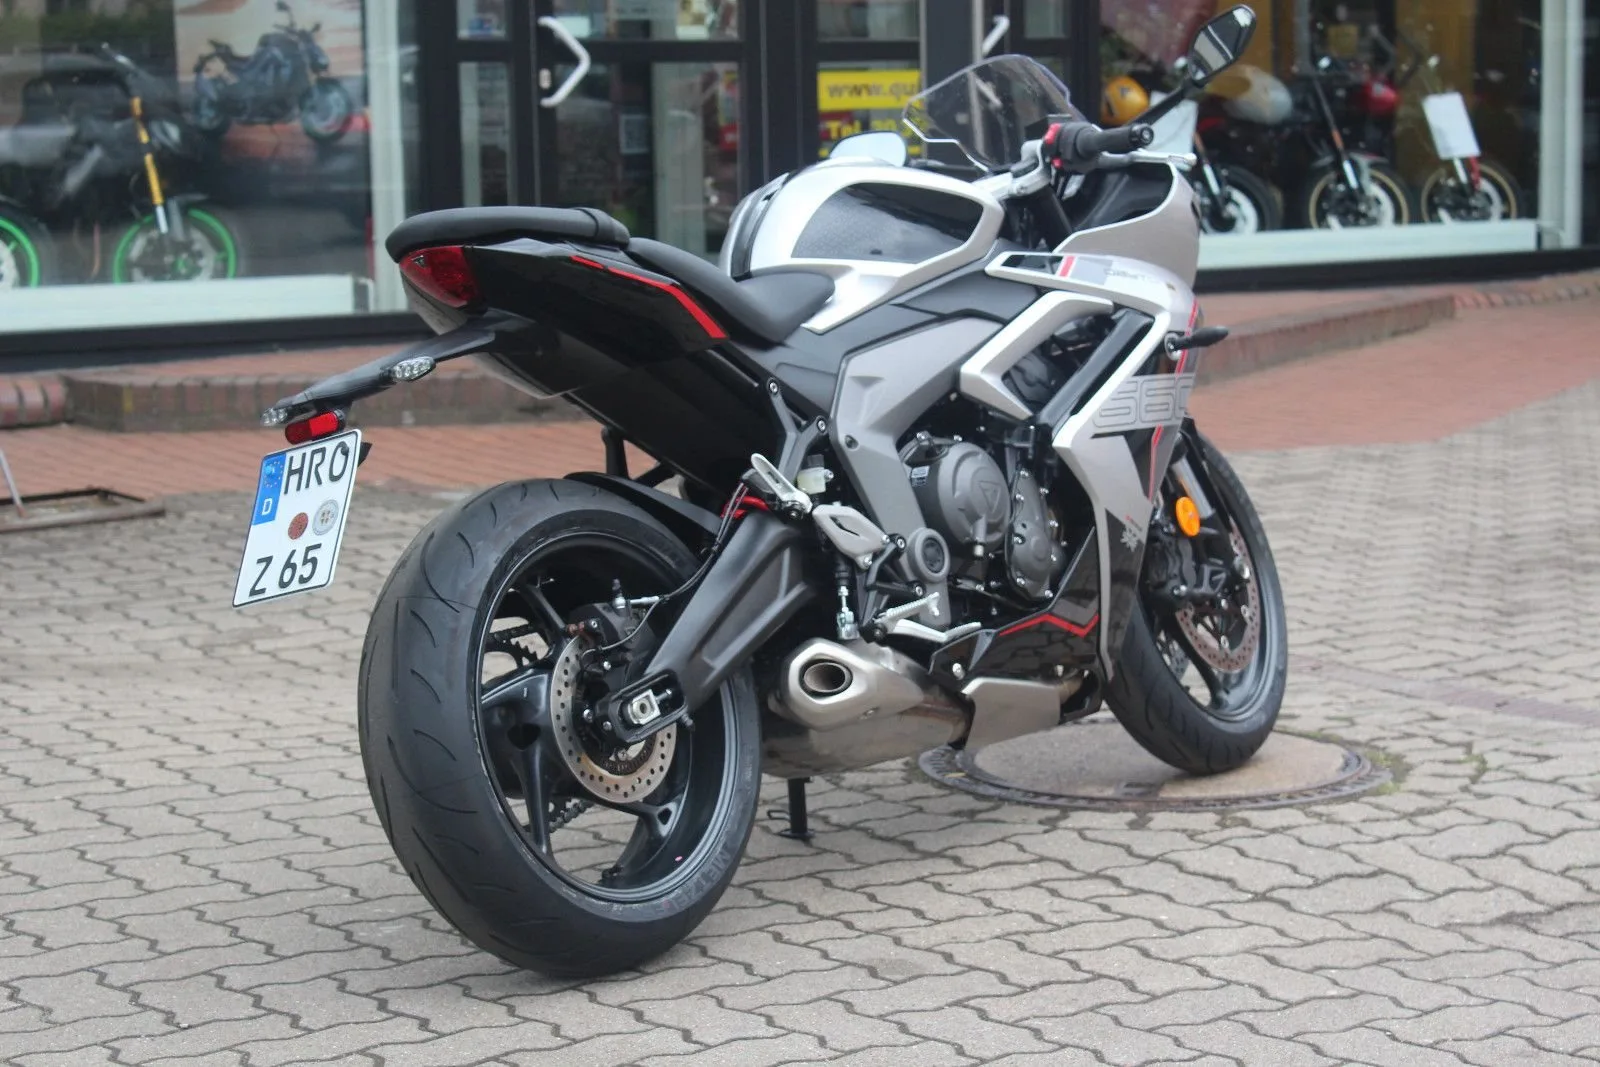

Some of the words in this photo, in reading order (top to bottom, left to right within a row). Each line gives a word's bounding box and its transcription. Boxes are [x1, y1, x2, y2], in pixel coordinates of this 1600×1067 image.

[283, 440, 350, 495] HRO
[261, 497, 273, 516] D
[249, 555, 274, 597] Z
[278, 543, 322, 589] 65
